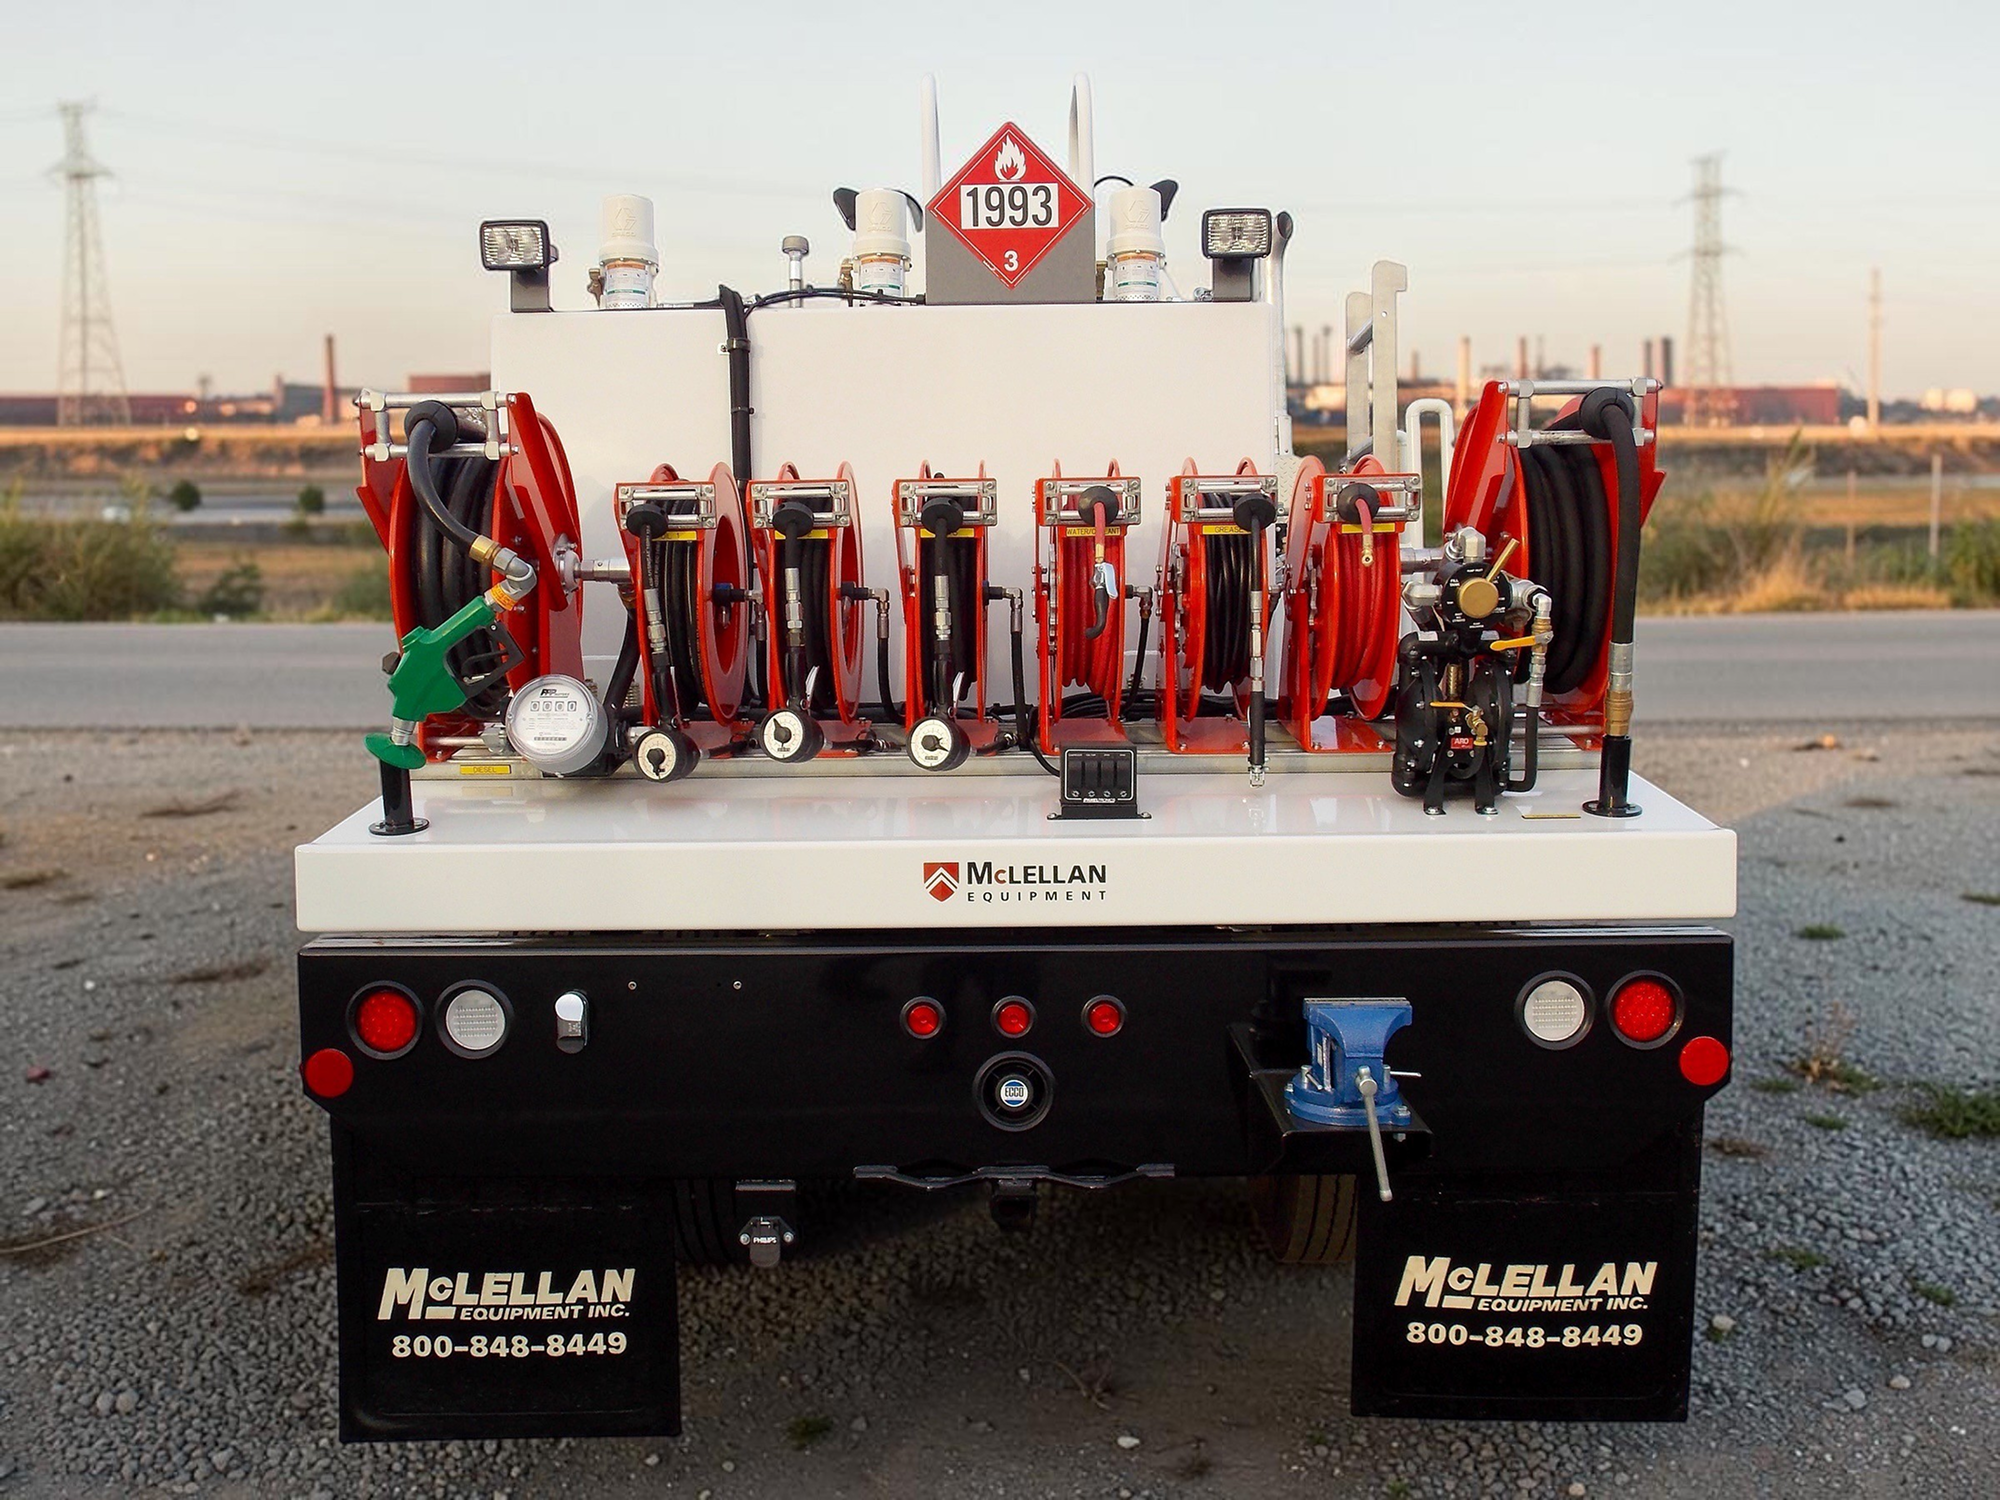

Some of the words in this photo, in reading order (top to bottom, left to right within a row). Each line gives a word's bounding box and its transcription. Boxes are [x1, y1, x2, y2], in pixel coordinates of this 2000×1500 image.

[966, 185, 1053, 227] 1993
[1003, 250, 1019, 272] 3
[1067, 527, 1120, 535] WATER/CLANT
[1454, 737, 1469, 745] ARO
[967, 861, 1106, 884] McLELLAN
[967, 890, 1107, 903] EQUIPMENT
[1005, 1087, 1024, 1097] ECCO
[1394, 1255, 1658, 1308] McLELLAN
[377, 1267, 636, 1320] McLELLAN
[1477, 1297, 1603, 1312] EQUIPMENT
[1606, 1296, 1648, 1311] INC.
[460, 1305, 583, 1321] EQUIPMENT
[588, 1303, 631, 1318] INC.
[392, 1332, 627, 1358] 800-848-8449
[1406, 1321, 1643, 1348] 800-848-8449
